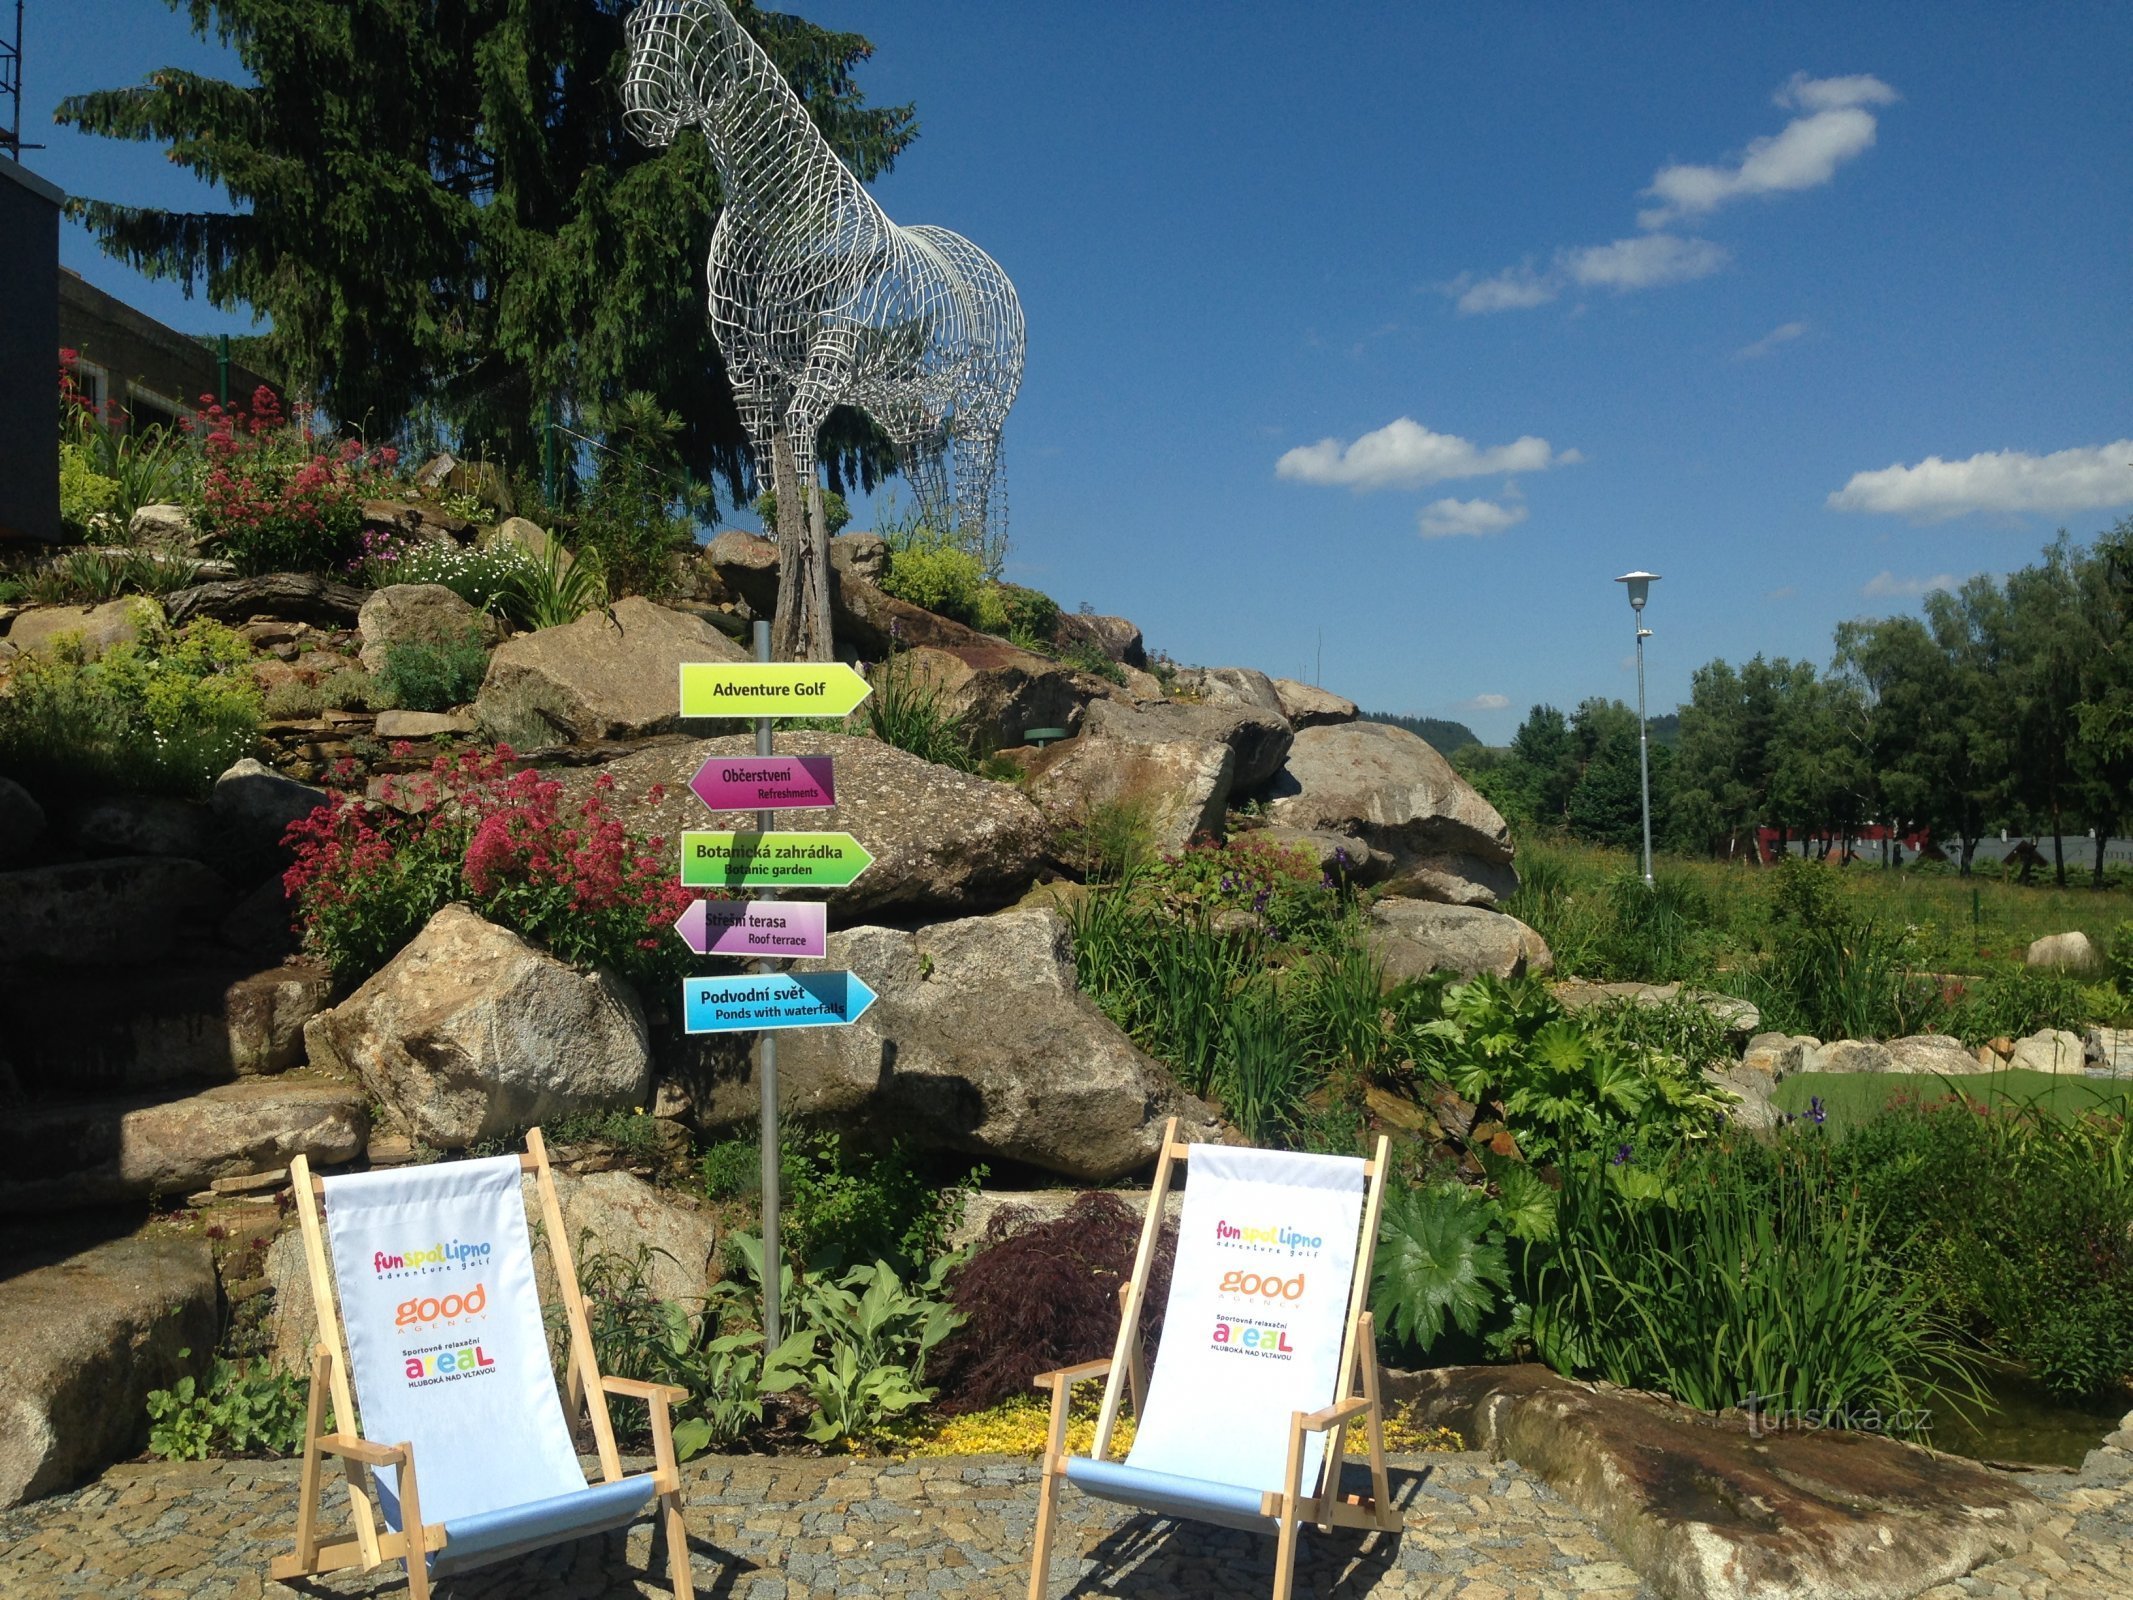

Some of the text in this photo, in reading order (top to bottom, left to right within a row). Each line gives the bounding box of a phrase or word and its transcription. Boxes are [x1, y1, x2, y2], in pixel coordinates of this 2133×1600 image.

[713, 682, 826, 696] Adventure Golf
[722, 768, 791, 783] Občerstvení
[758, 788, 819, 799] Refreshments
[697, 845, 842, 859] Botanická zahrádka
[725, 864, 812, 877] Botanic garden
[705, 914, 786, 928] Střešní terasa
[748, 934, 806, 946] Roof terrace
[701, 986, 805, 1004] Podvodní svět
[716, 1003, 845, 1020] Ponds with waterfalls
[1219, 1270, 1305, 1300] good
[395, 1283, 486, 1326] good
[397, 1315, 487, 1334] AGENCY
[1216, 1314, 1287, 1329] Sportovně relaxační
[403, 1338, 480, 1356] Sportovně relaxační
[1211, 1344, 1243, 1354] HLUBOKÁ
[1261, 1352, 1292, 1360] VLTAVOU
[409, 1367, 496, 1388] HLUBOKÁ NAD VLTAVOU
